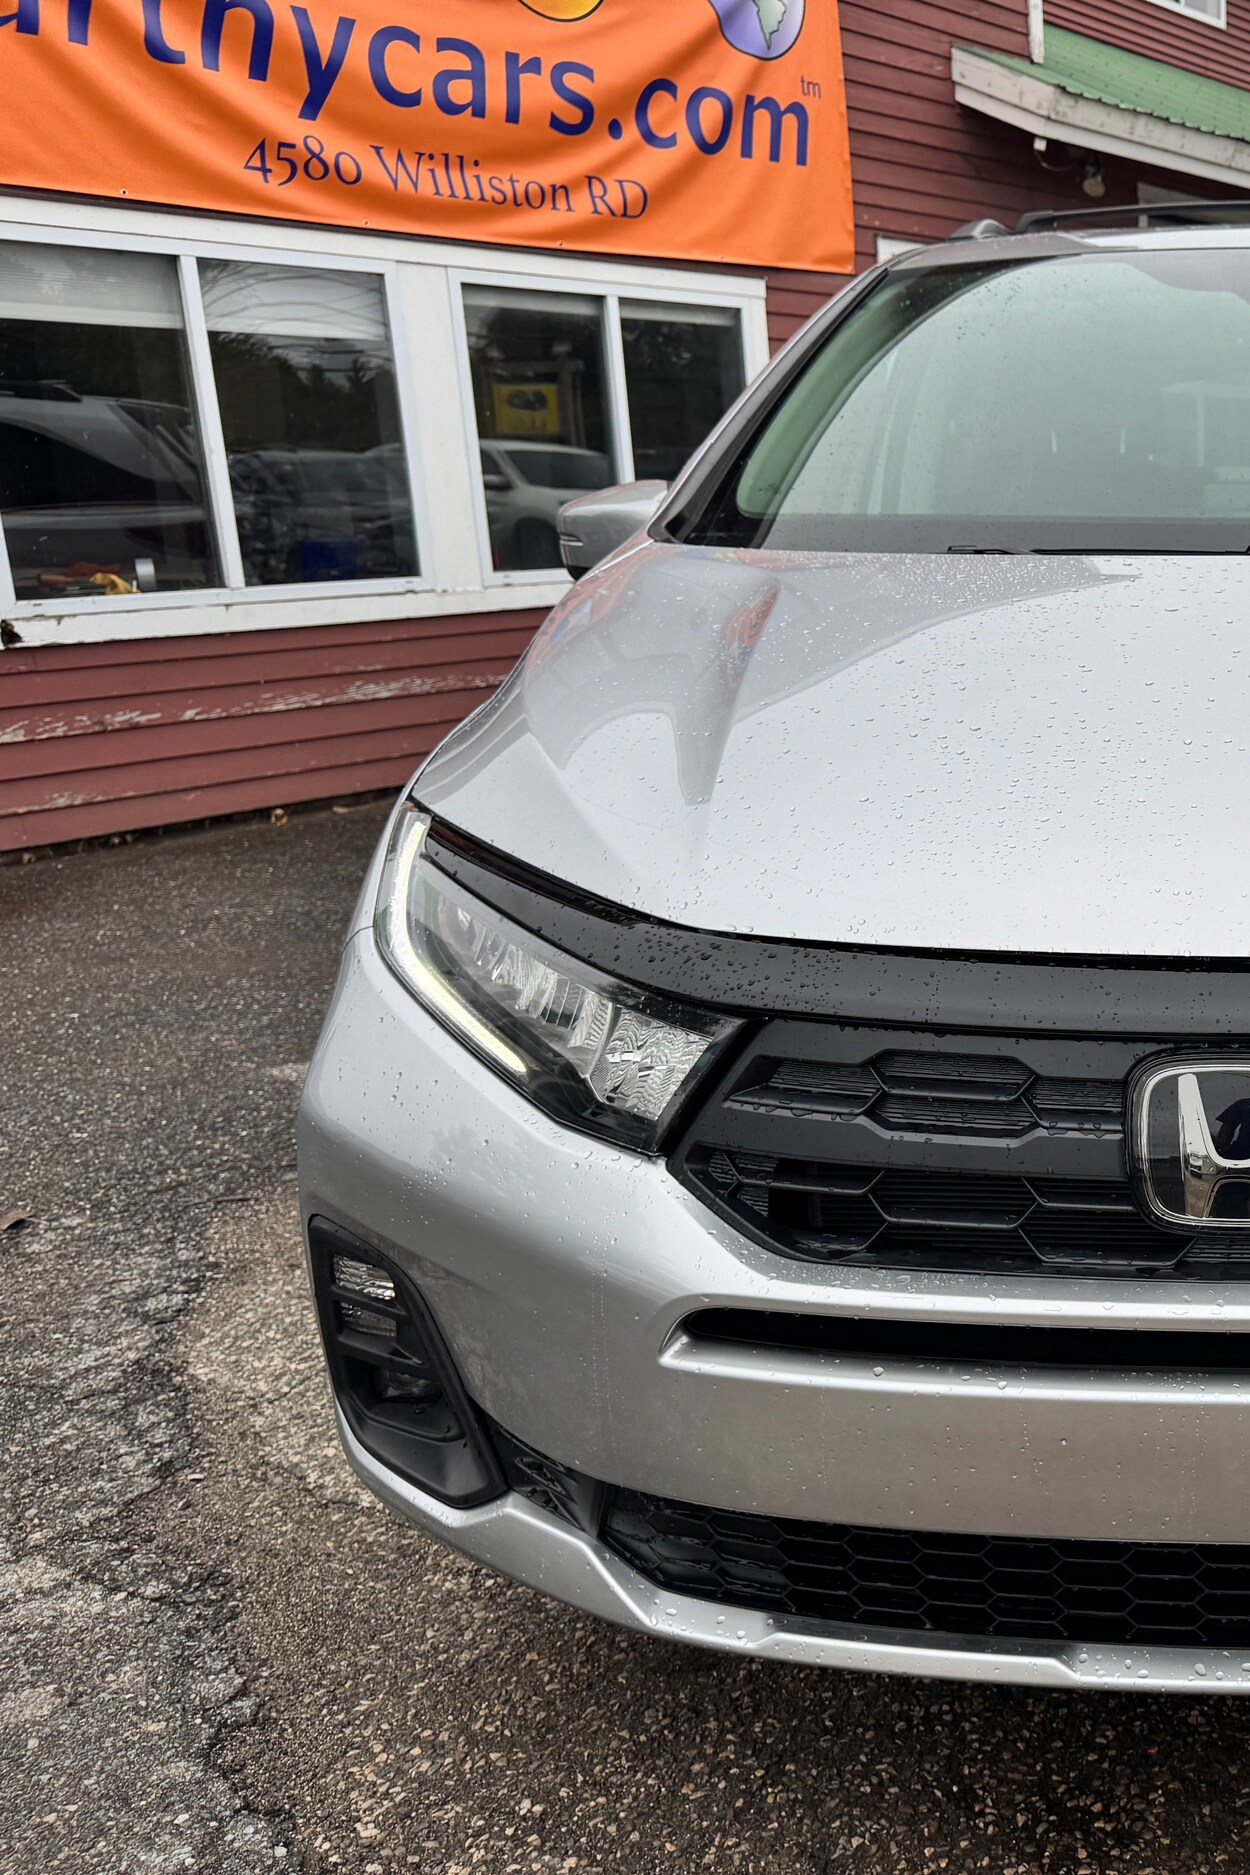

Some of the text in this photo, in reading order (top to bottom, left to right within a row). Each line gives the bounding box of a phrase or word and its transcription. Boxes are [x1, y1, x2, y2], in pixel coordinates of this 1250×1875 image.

[800, 75, 822, 99] tm
[243, 135, 649, 219] 4580 Williston RD
